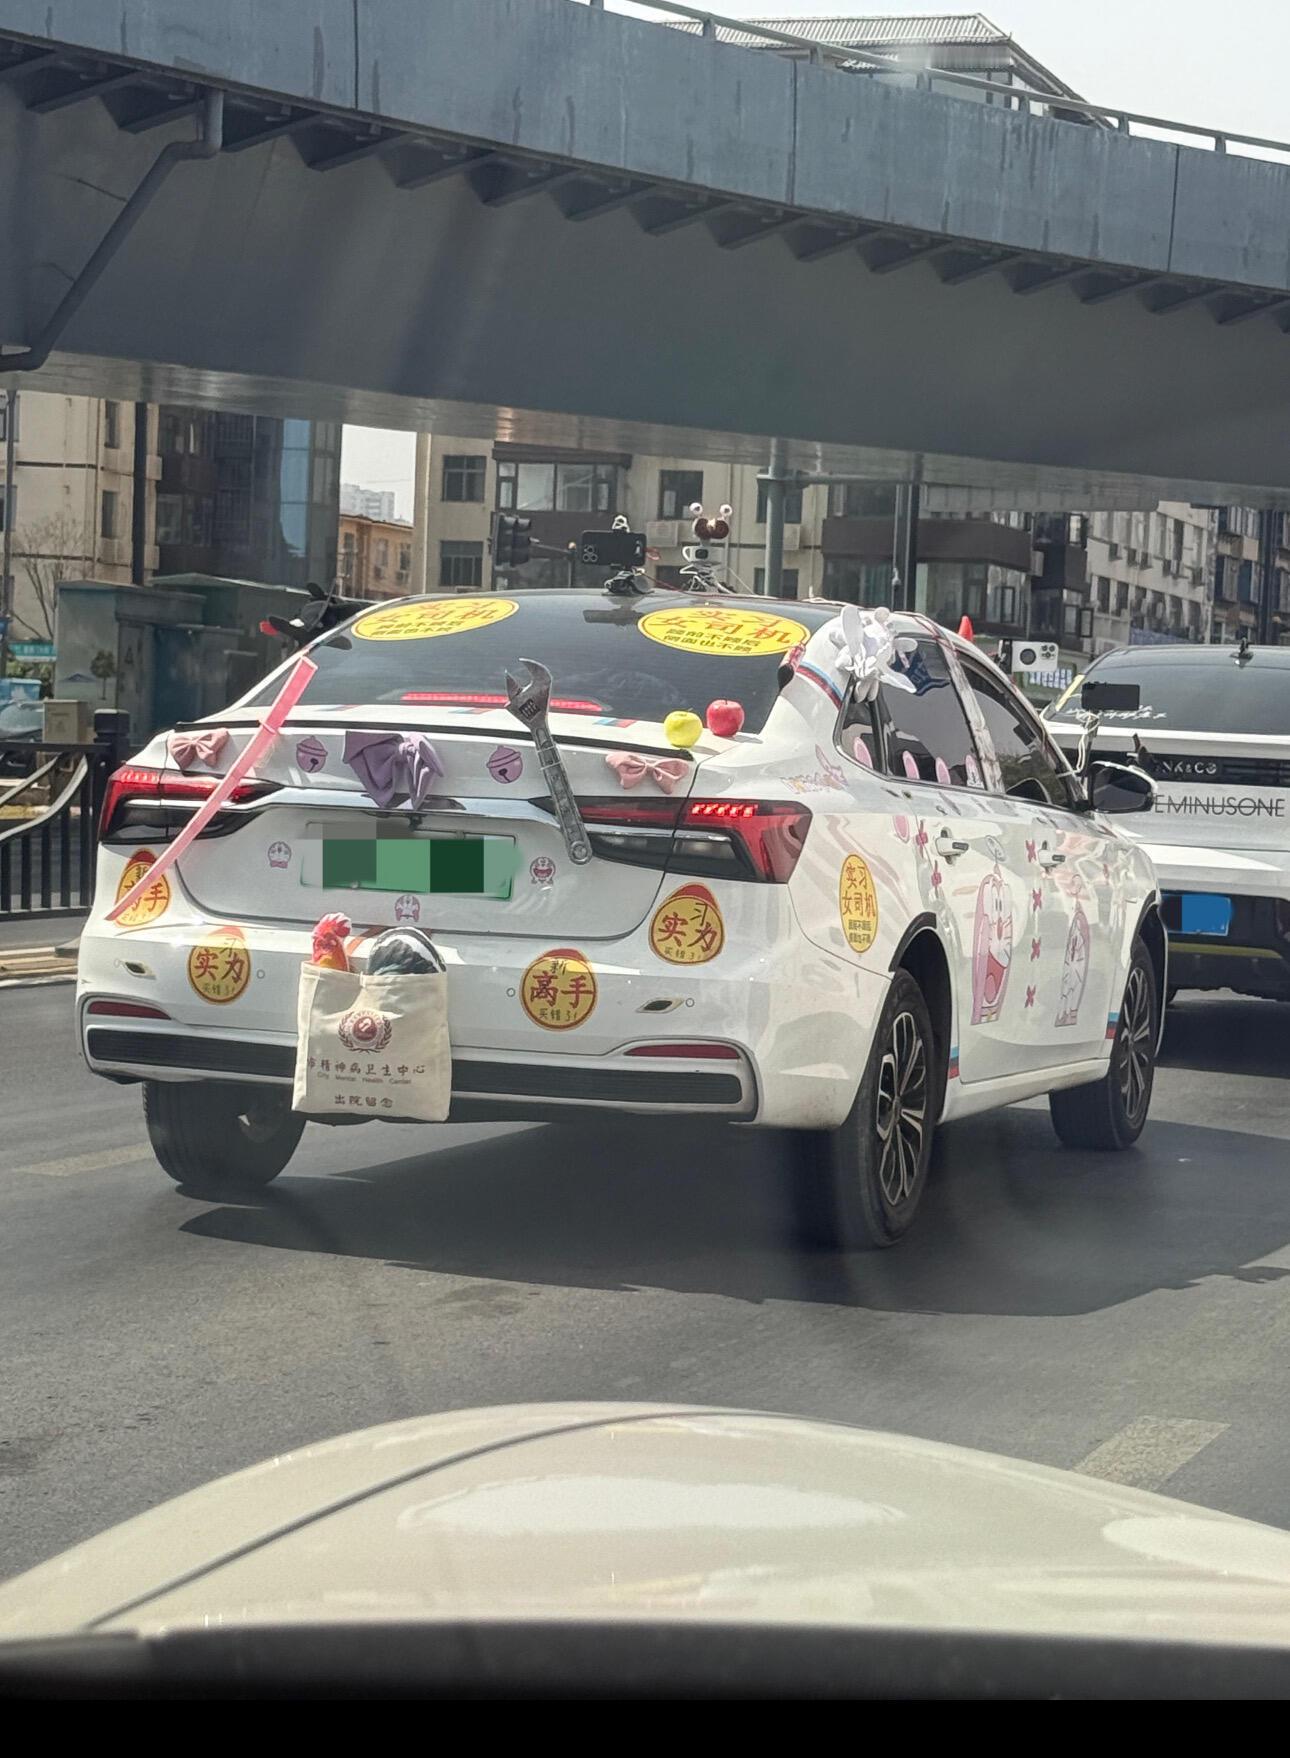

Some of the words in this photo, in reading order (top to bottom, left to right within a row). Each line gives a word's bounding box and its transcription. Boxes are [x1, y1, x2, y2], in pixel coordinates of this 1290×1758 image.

[649, 617, 790, 643] 女司机
[688, 609, 784, 628] 实习
[845, 862, 868, 890] 实习
[841, 890, 876, 918] 女司机
[335, 1094, 394, 1109] 出院留念
